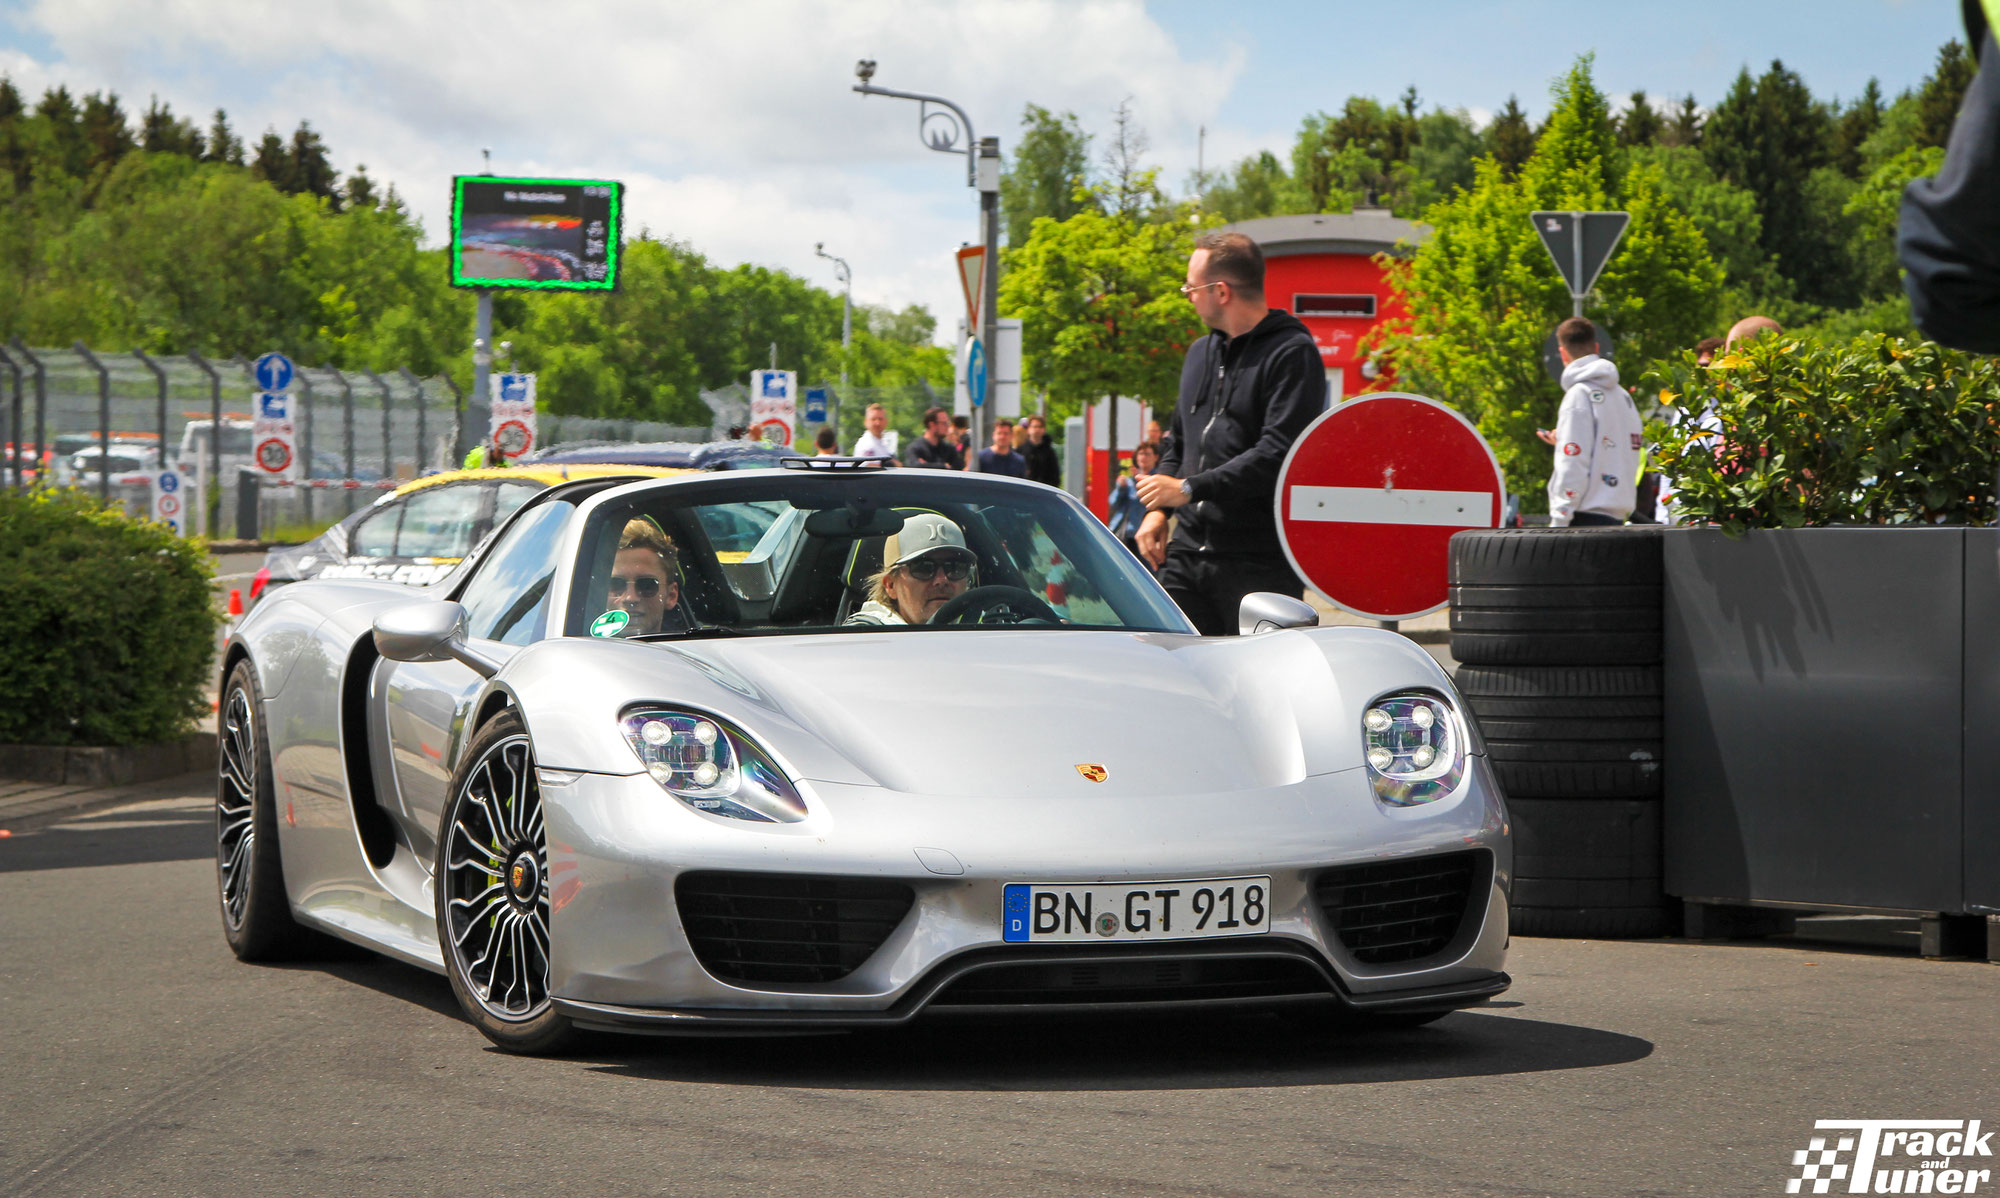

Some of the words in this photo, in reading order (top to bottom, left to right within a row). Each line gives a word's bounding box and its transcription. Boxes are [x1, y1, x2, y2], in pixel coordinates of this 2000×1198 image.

[606, 612, 616, 624] 4
[1012, 919, 1022, 932] D
[1033, 892, 1093, 934] BN
[1125, 890, 1181, 933] GT
[1192, 884, 1265, 930] 918
